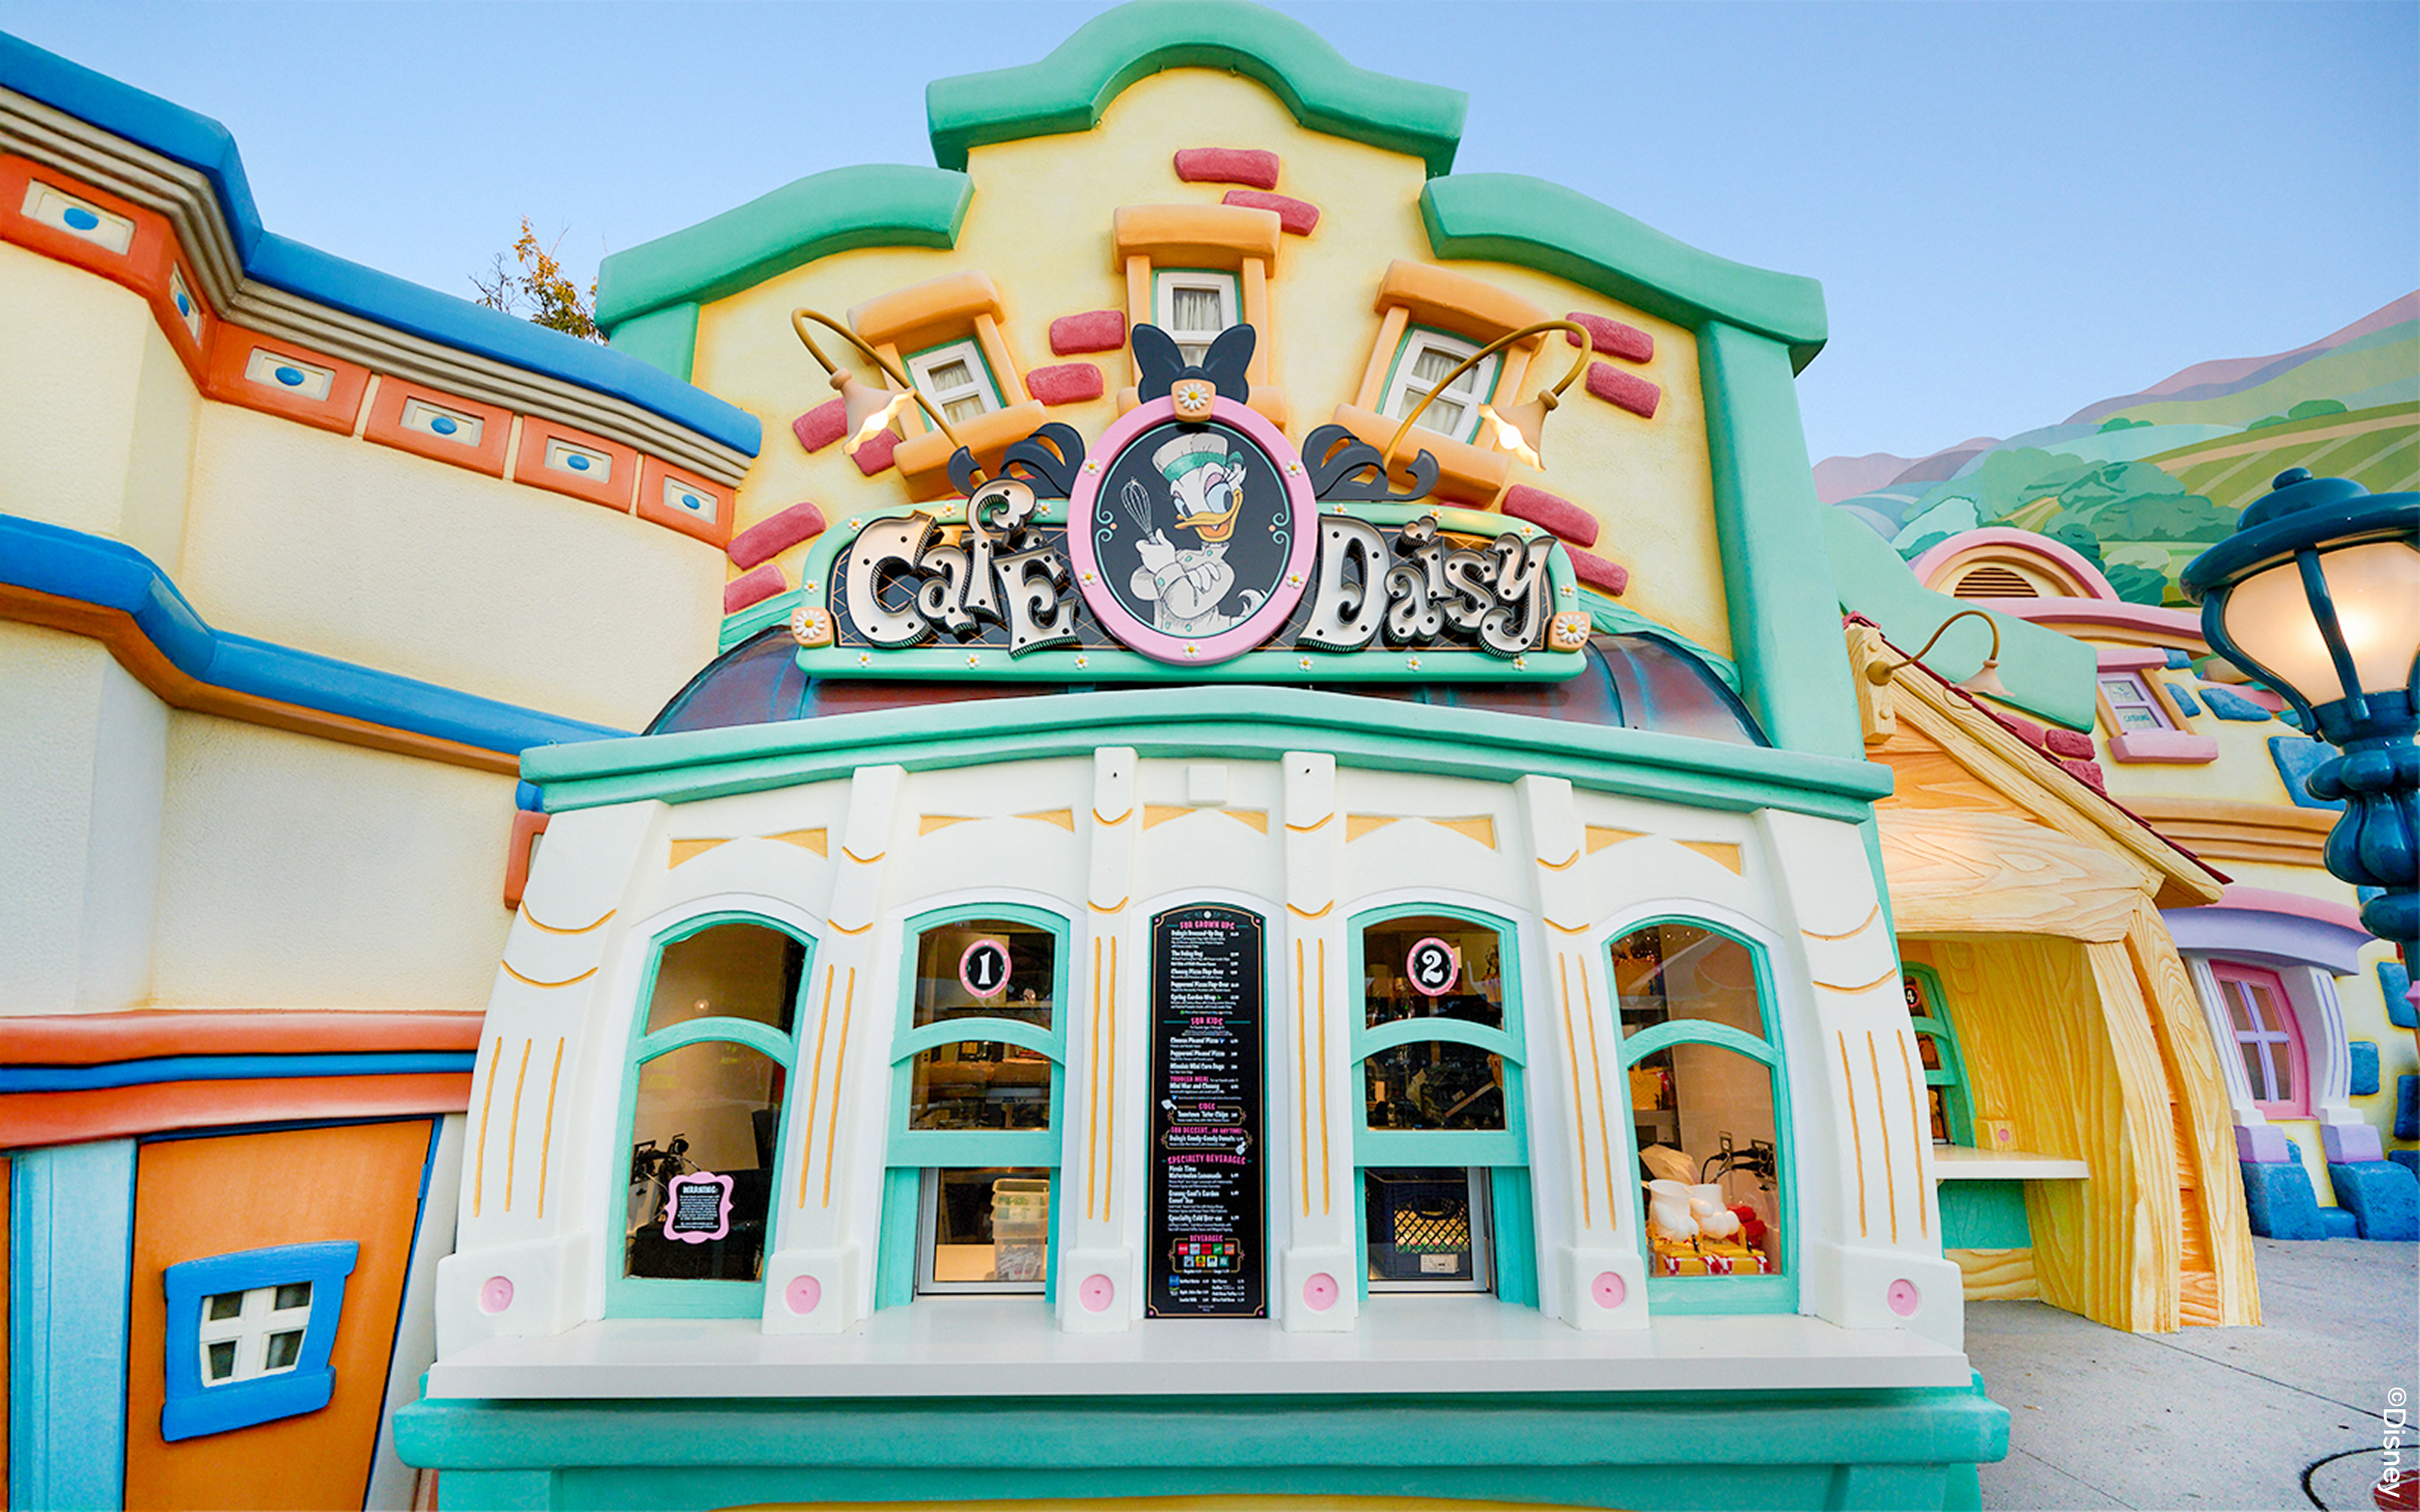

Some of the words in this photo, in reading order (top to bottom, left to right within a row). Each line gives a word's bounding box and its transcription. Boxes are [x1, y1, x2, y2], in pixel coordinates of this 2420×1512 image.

[1296, 513, 1559, 658] Daisy
[1180, 921, 1193, 930] FOR
[1195, 920, 1220, 929] GROWN
[1221, 921, 1235, 930] UPS
[977, 950, 991, 985] 1
[1421, 950, 1444, 984] 2
[1905, 989, 1916, 1003] 4
[1190, 1017, 1204, 1026] FOR
[1206, 1017, 1224, 1026] KIDS
[1213, 1062, 1224, 1071] Dogs
[1198, 1102, 1215, 1111] SIDES
[1168, 1154, 1204, 1164] SPECIALTY
[1205, 1154, 1246, 1165] BEVERAGES
